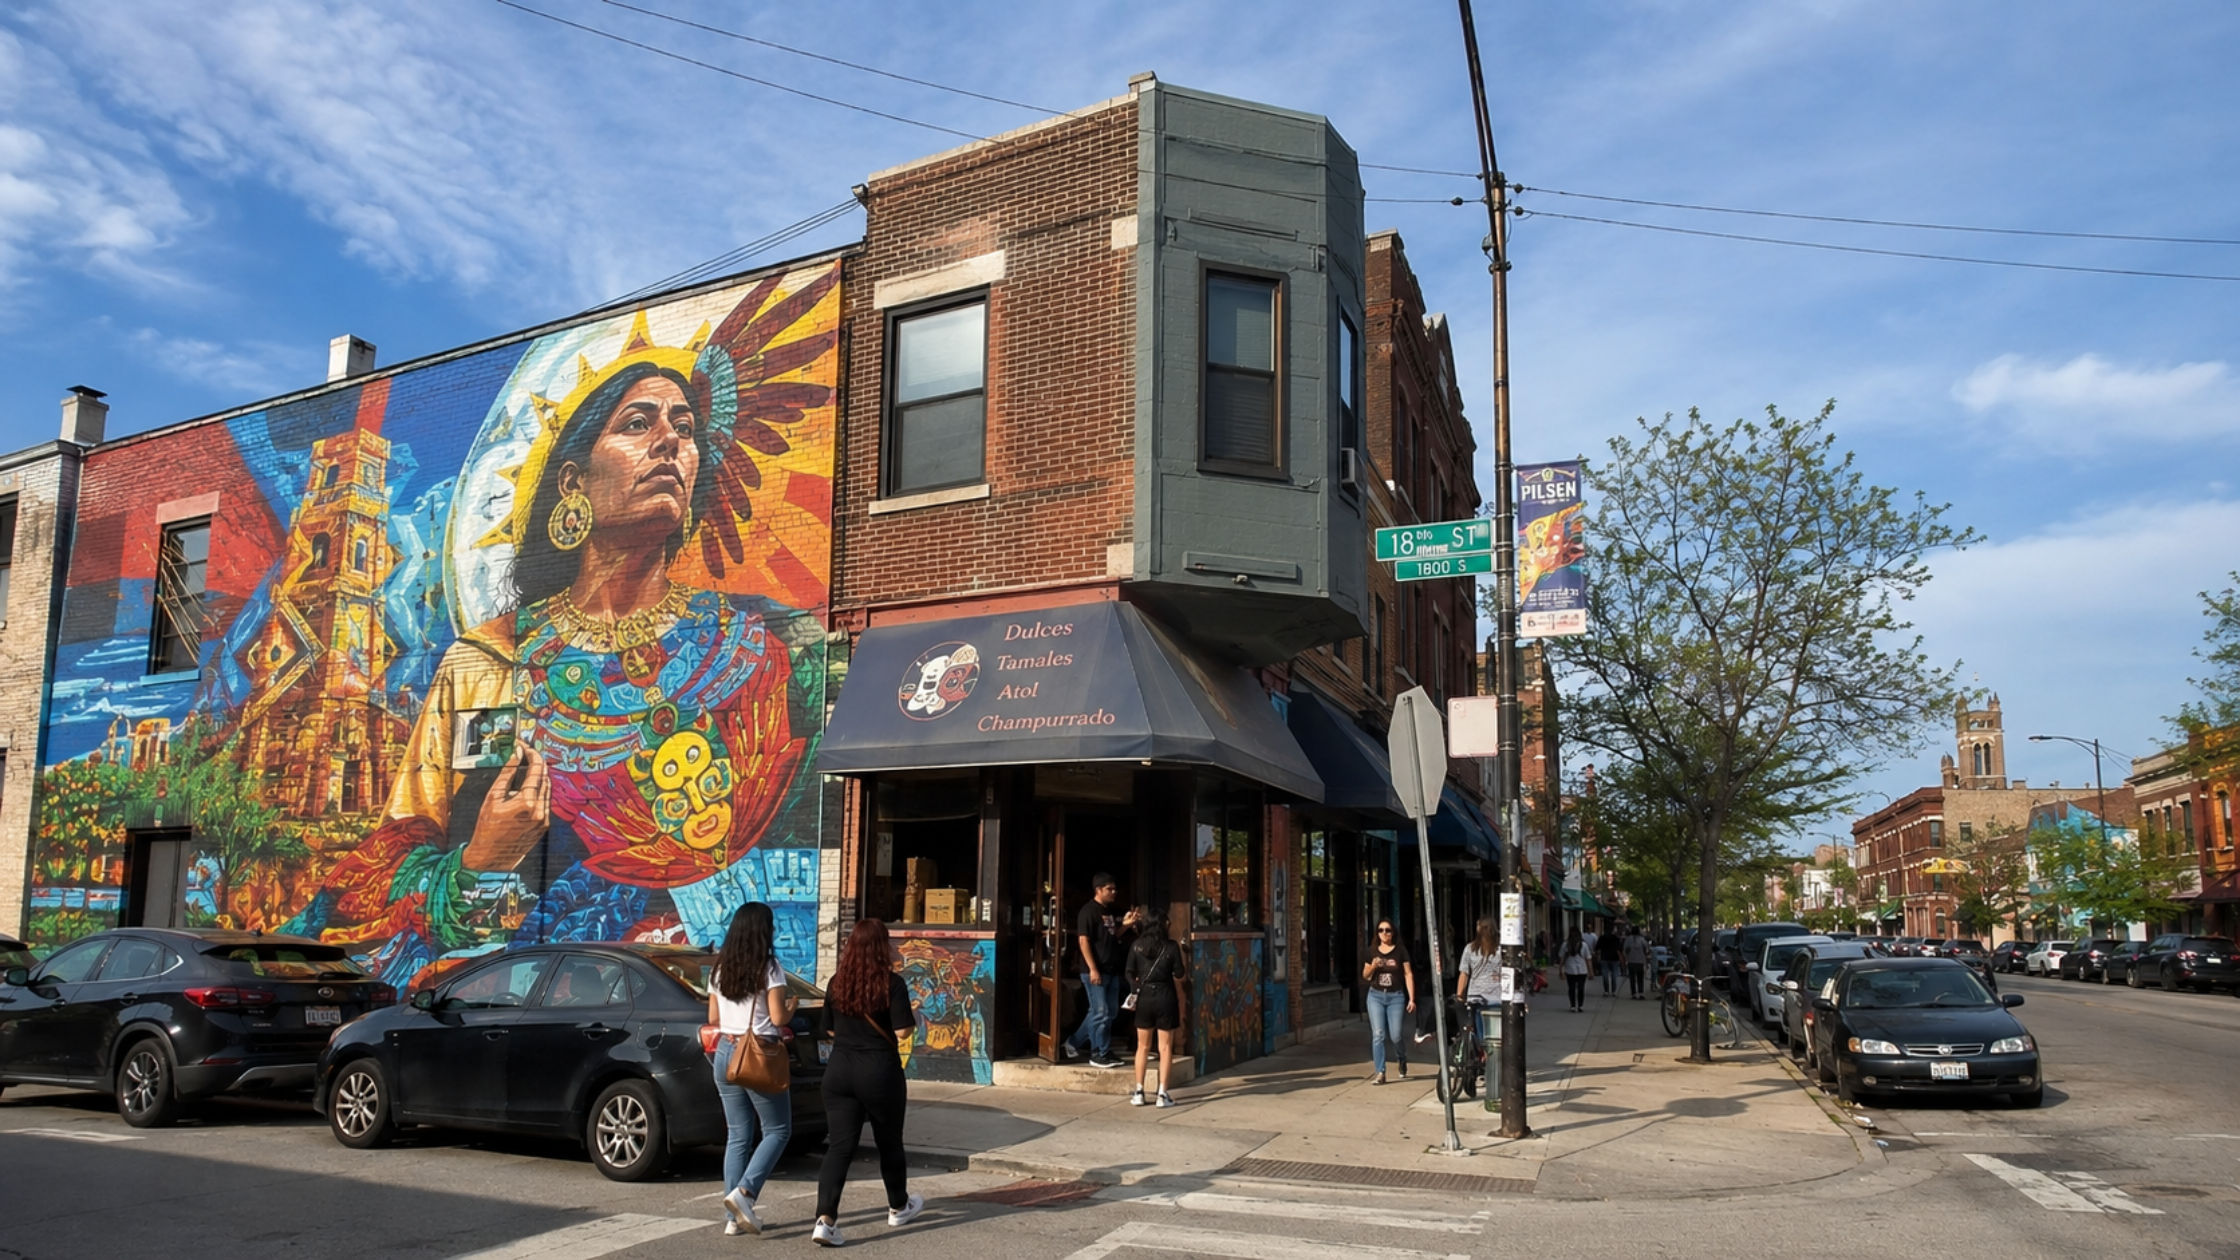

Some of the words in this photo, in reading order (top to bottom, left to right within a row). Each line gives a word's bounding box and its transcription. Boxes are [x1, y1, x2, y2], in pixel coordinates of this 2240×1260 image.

[1521, 481, 1577, 501] PILSEN
[1391, 531, 1414, 555] 18
[1452, 525, 1477, 548] ST
[1417, 560, 1451, 576] 1800
[1458, 559, 1467, 572] S
[1004, 621, 1074, 641] Dulces
[997, 650, 1074, 671] Tamales
[997, 682, 1039, 700] Atol
[977, 708, 1116, 733] Champurrado
